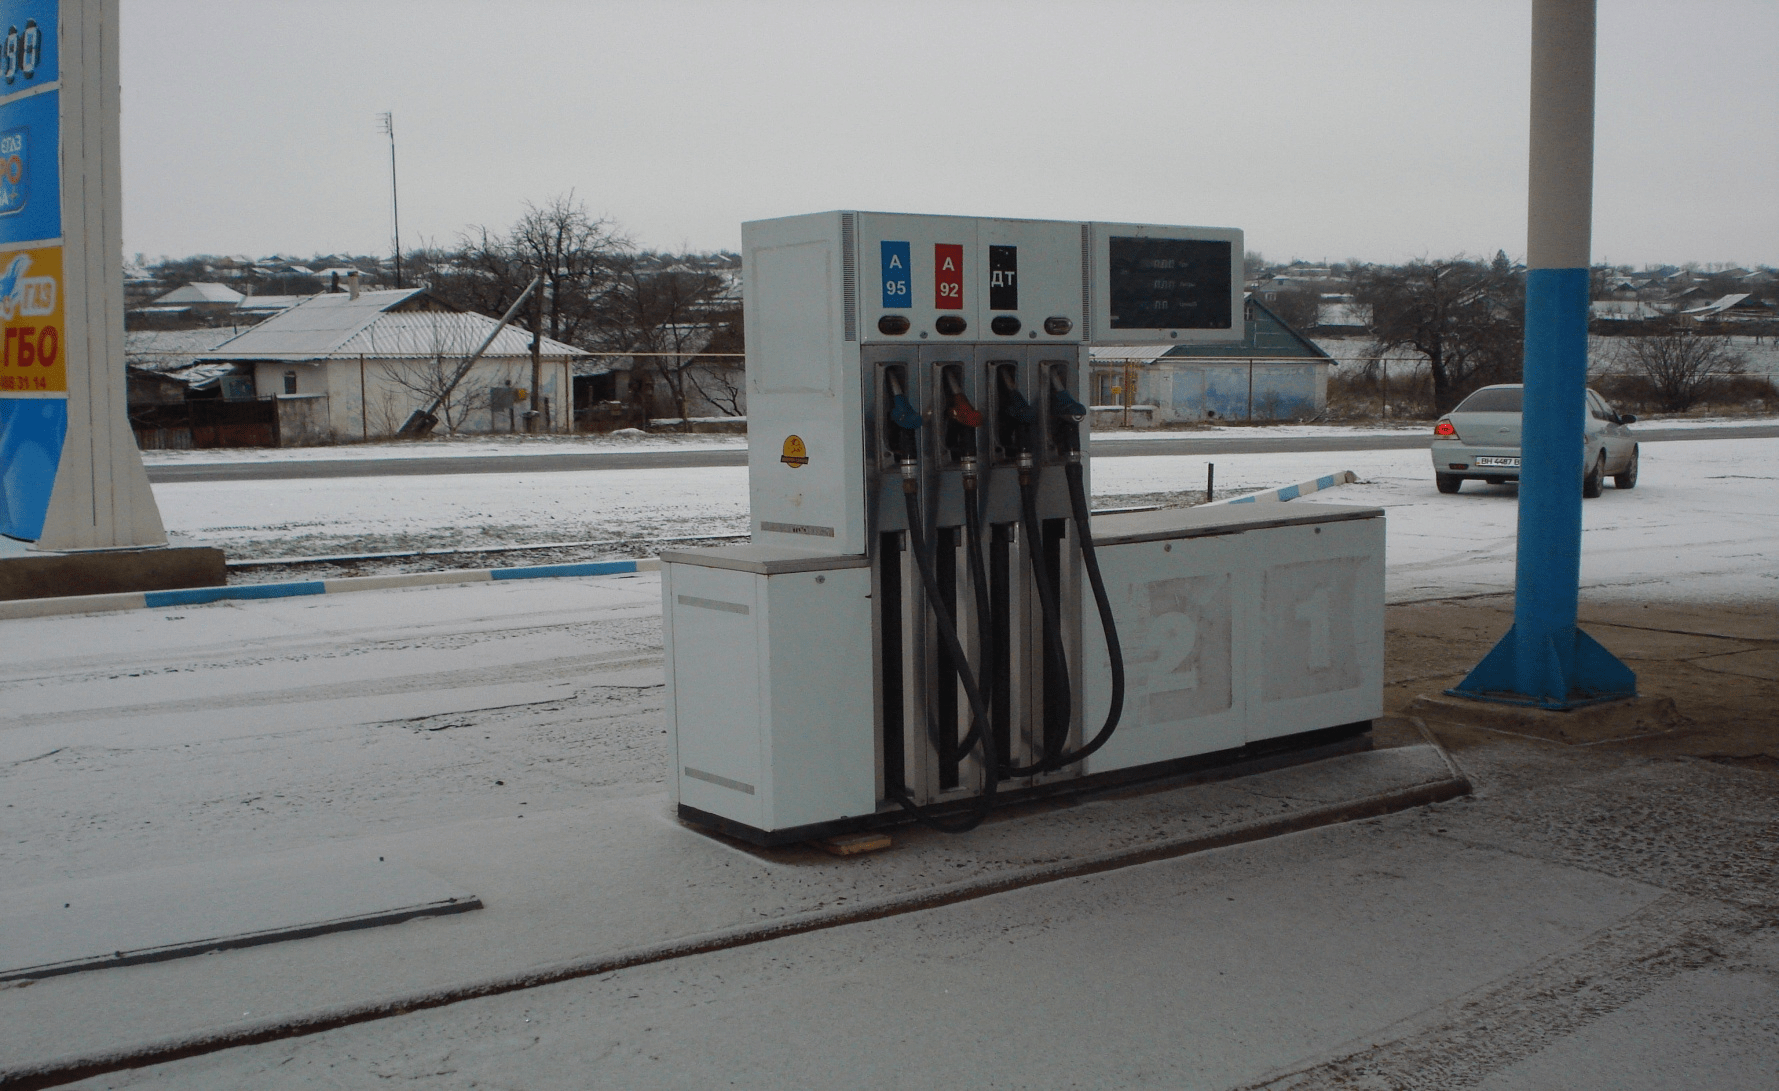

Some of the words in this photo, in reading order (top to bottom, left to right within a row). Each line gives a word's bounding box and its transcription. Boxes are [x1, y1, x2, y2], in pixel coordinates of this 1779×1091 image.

[889, 254, 902, 269] А
[942, 256, 955, 272] А
[991, 270, 1015, 288] ДТ
[886, 280, 907, 296] 95
[940, 282, 959, 298] 92
[4, 325, 58, 367] ГБО
